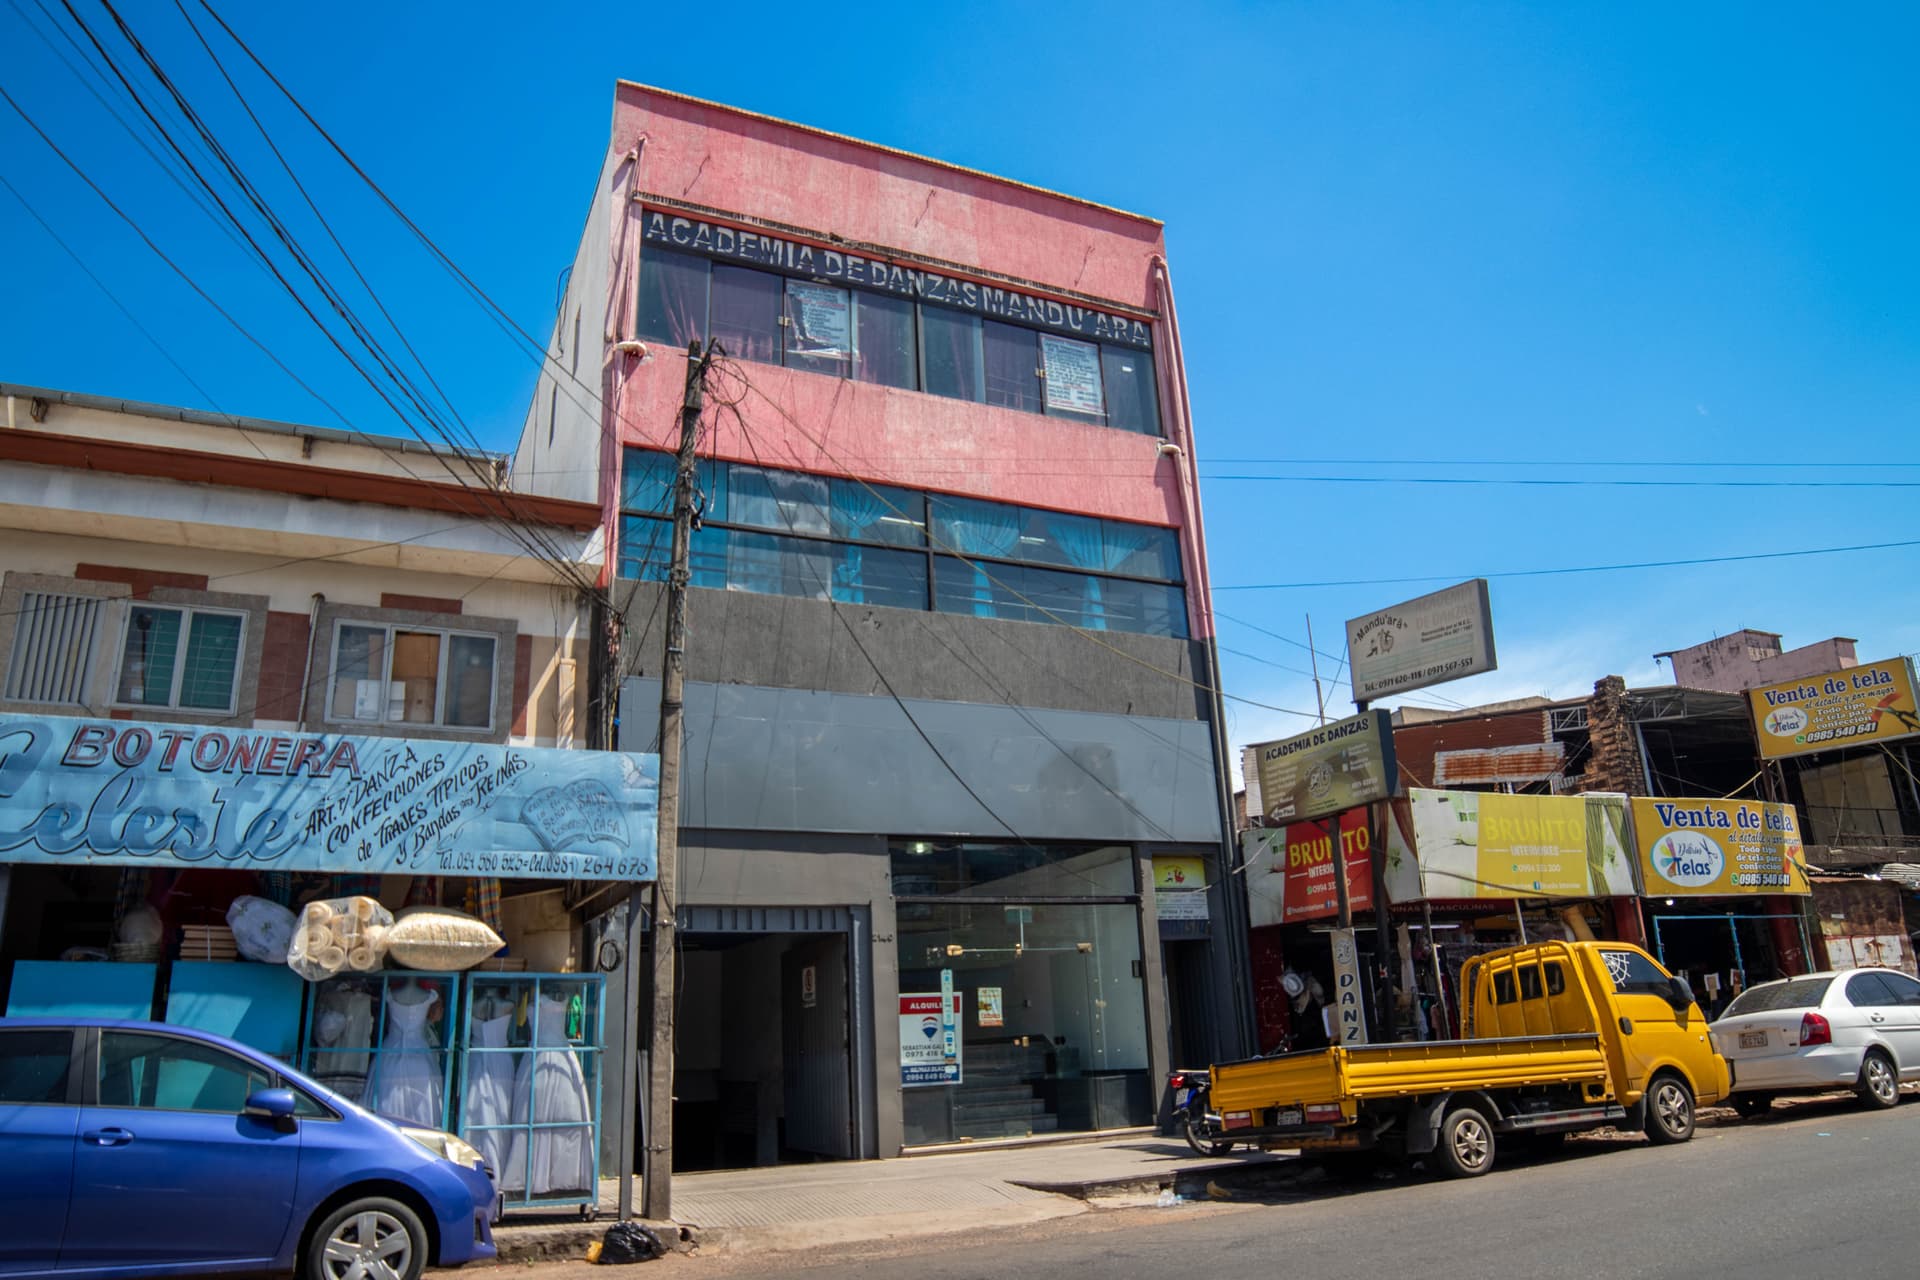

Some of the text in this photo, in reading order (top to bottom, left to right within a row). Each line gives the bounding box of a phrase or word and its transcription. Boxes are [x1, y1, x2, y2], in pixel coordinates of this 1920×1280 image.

[646, 212, 816, 273] ACADEMIA
[824, 251, 865, 282] DE
[870, 261, 977, 308] DANZAS
[1765, 669, 1892, 706] Venta de tela
[1804, 700, 1814, 709] al
[1815, 695, 1842, 708] detalle
[1868, 686, 1896, 698] mayor
[1812, 707, 1873, 724] de tela para
[1817, 702, 1865, 716] Todo tipo
[1265, 718, 1369, 761] ACADEMIA DE DANZAS
[1777, 721, 1800, 733] Telas
[1807, 721, 1877, 743] 0985 540 641
[61, 724, 364, 782] BOTONERA
[470, 751, 528, 808] REINAS
[303, 804, 337, 845] ART.
[351, 746, 419, 809] DANZA
[327, 753, 446, 853] CONFECCIONES
[357, 754, 489, 862] de TRAJES TIPICOS
[1484, 817, 1582, 842] BRUNITO
[1654, 803, 1794, 832] Venta de tela
[1289, 826, 1369, 867] BRUNTO
[1728, 831, 1737, 843] al
[1739, 831, 1765, 844] detalle
[1739, 845, 1761, 854] Todo
[1675, 857, 1711, 876] Telas
[1736, 854, 1746, 862] de
[1748, 854, 1764, 862] tela
[1739, 873, 1762, 886] 0985
[1762, 874, 1778, 886] 540
